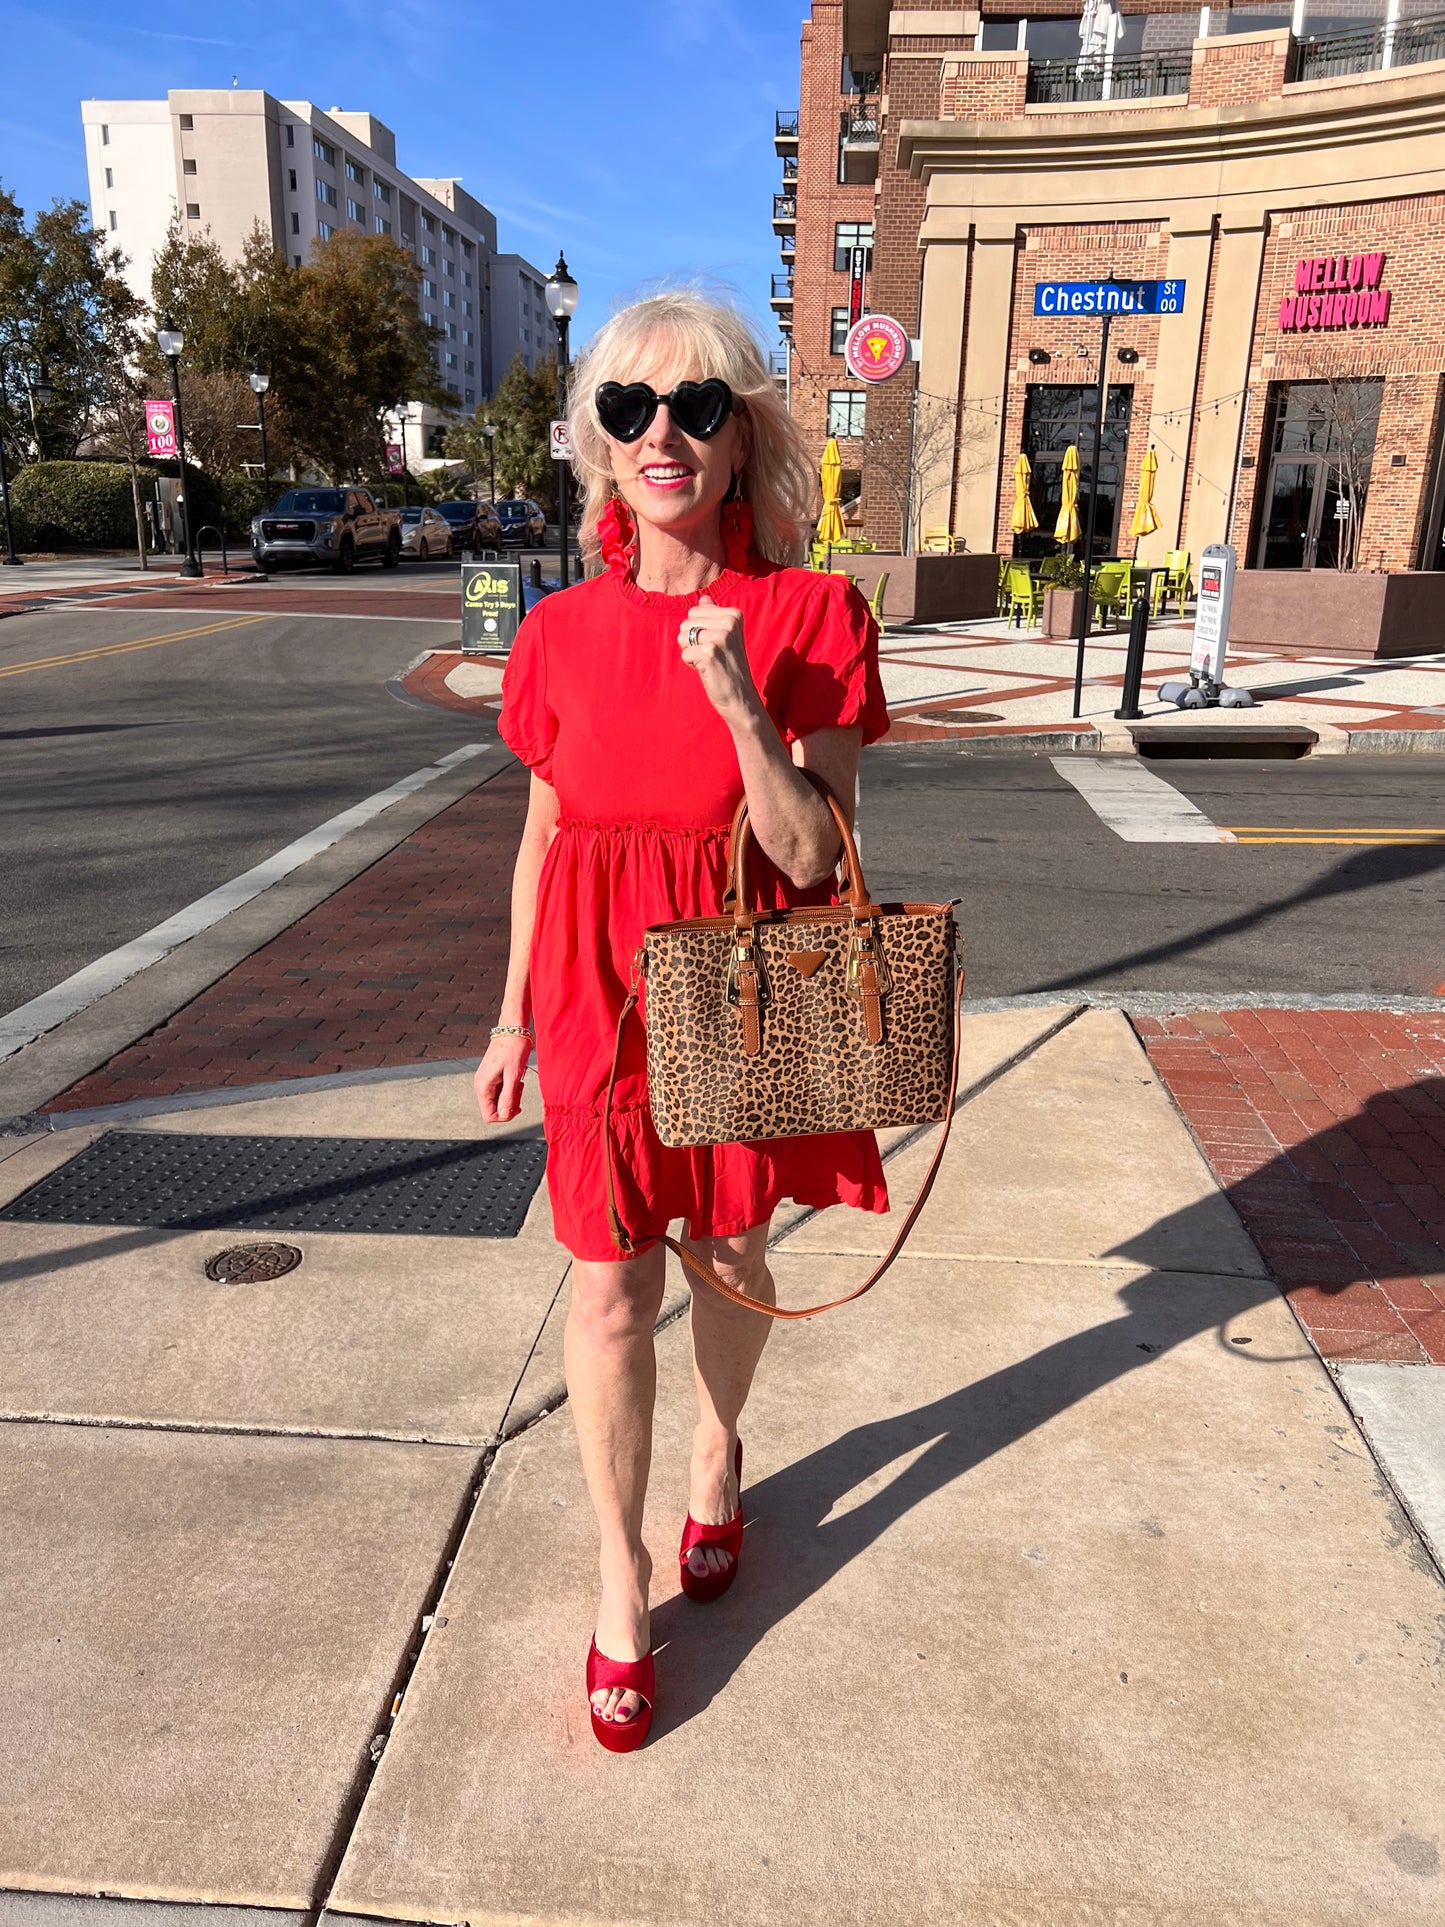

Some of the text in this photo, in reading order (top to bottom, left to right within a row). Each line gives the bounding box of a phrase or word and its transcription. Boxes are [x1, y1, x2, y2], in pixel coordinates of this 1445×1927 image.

[1294, 252, 1386, 292] MELLOW
[1041, 282, 1177, 311] Chestnut St
[1160, 299, 1177, 312] 00
[1278, 290, 1391, 331] MUSHROOM
[852, 322, 901, 359] MELLOW MUSHROOM
[151, 434, 173, 450] 100
[484, 601, 495, 610] Try
